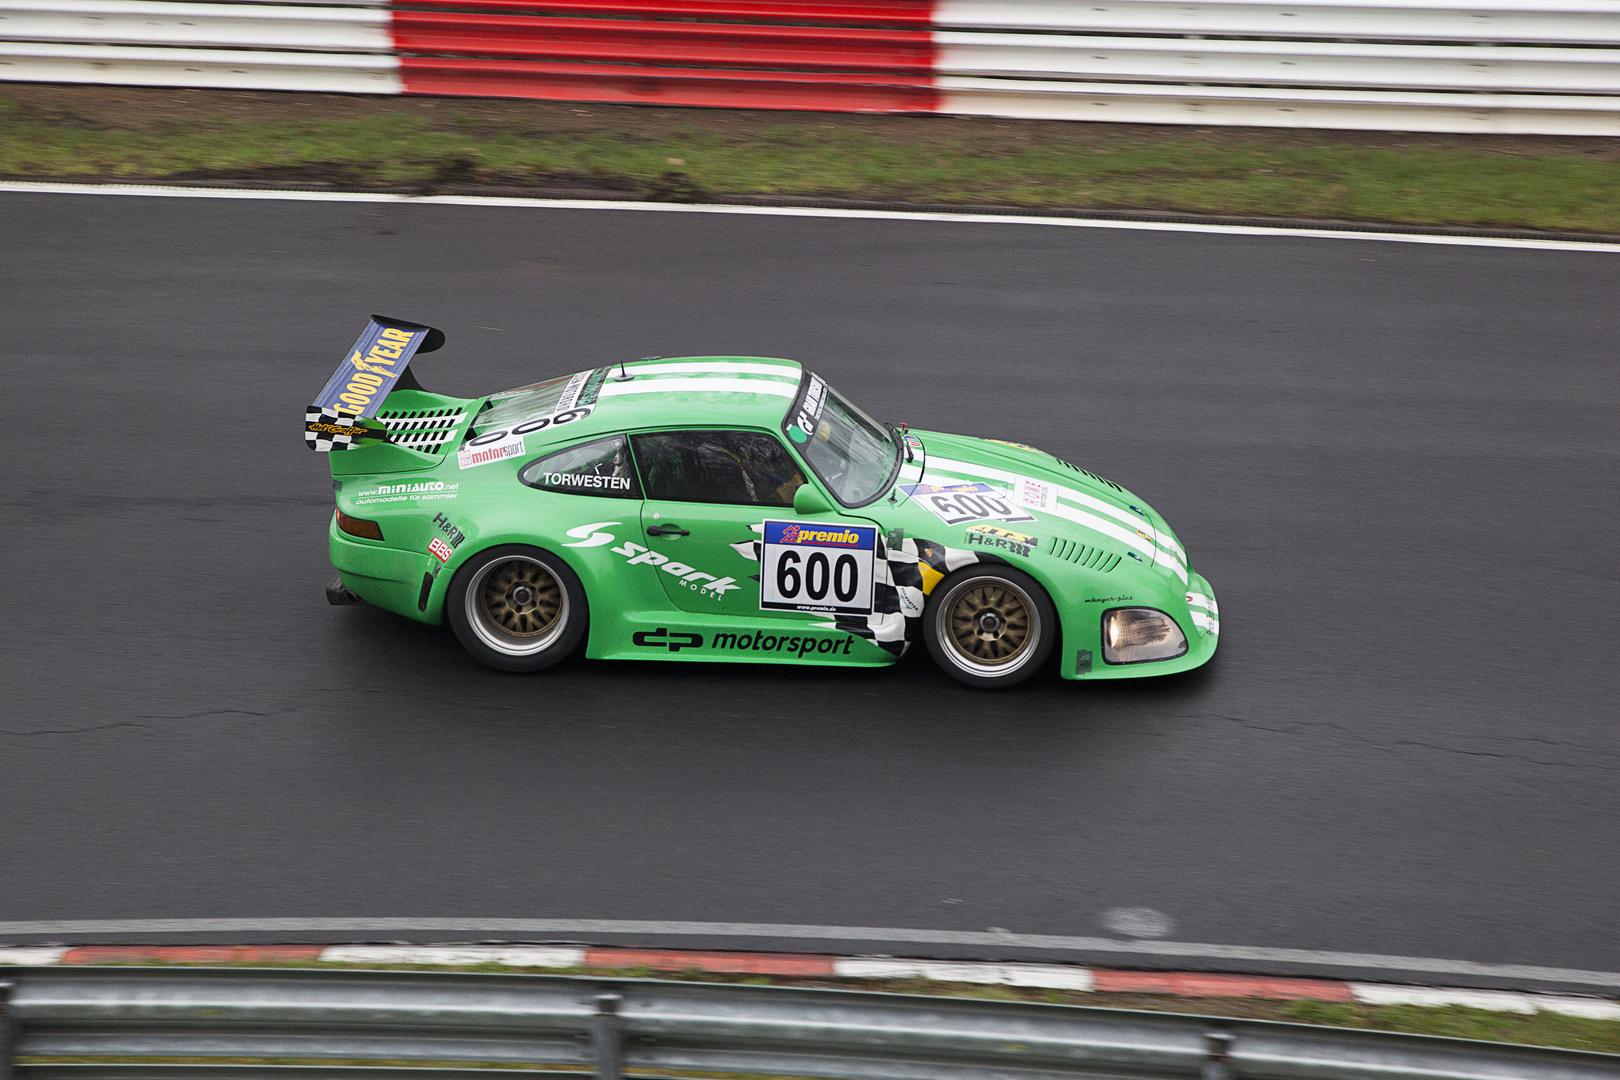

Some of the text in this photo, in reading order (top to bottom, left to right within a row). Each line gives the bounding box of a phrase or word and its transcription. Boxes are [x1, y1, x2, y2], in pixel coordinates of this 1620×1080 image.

[469, 408, 592, 447] 600
[543, 472, 631, 490] TORWESTEN
[355, 494, 408, 505] automodelle
[421, 492, 458, 501] sammler
[797, 529, 860, 544] premio
[428, 537, 453, 562] BBS
[776, 550, 859, 603] 600
[678, 579, 723, 601] MODEL
[712, 630, 855, 658] motorsport
